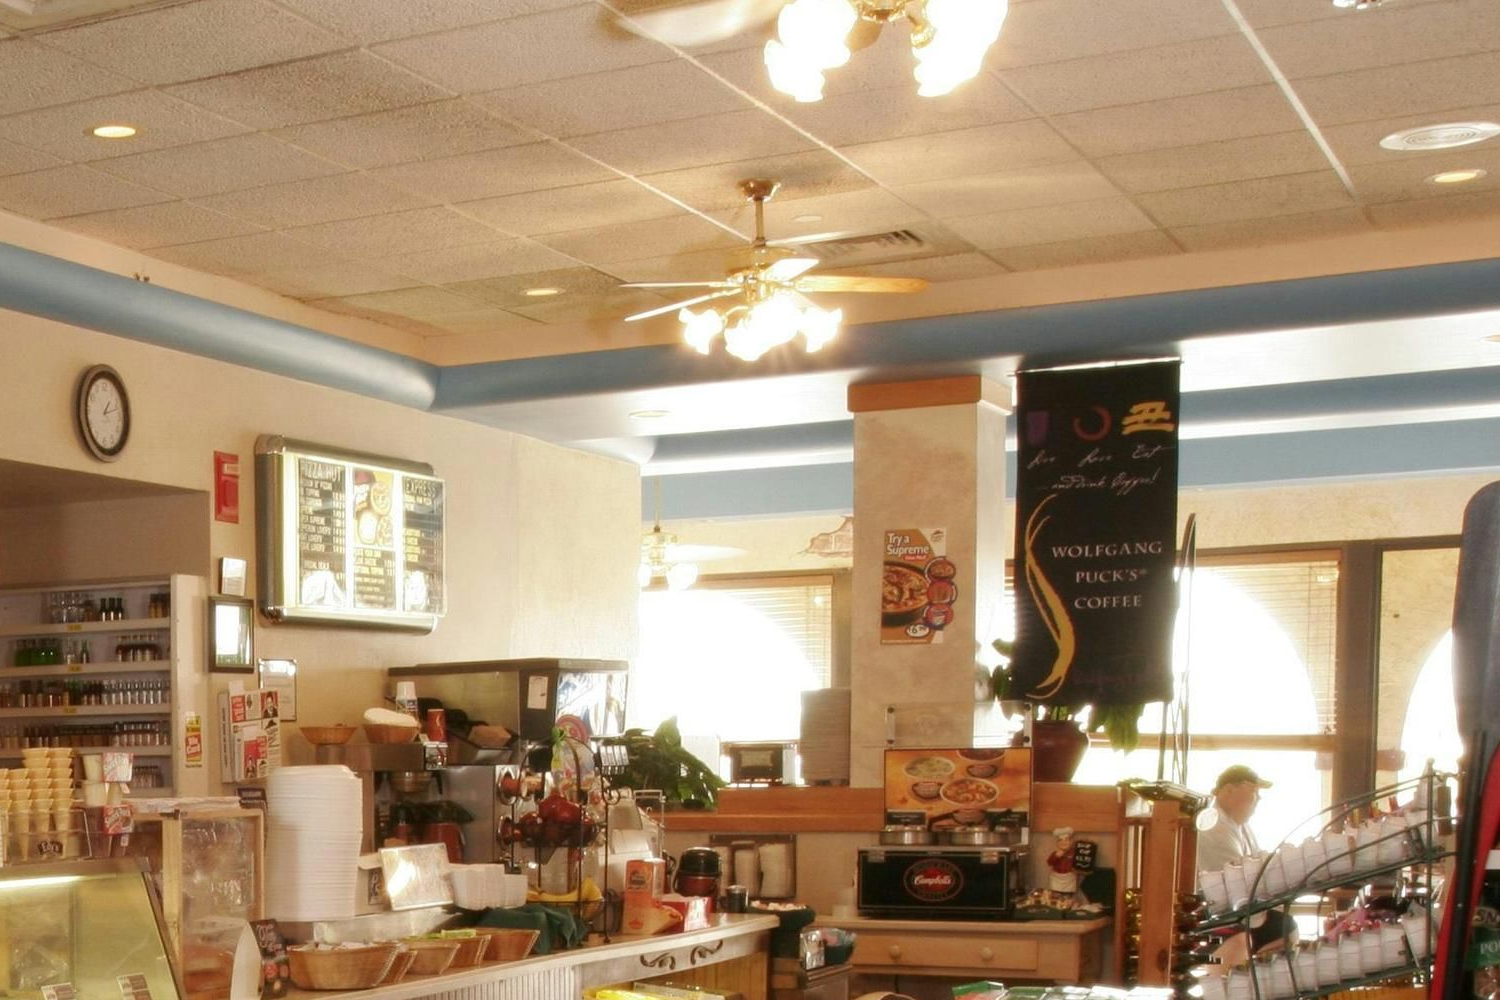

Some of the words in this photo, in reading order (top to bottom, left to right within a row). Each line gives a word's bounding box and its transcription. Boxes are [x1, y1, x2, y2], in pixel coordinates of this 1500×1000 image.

[887, 533, 900, 546] Try
[887, 544, 929, 557] Supreme
[1052, 541, 1162, 558] WOLFGANG
[1074, 595, 1142, 609] COFFEE
